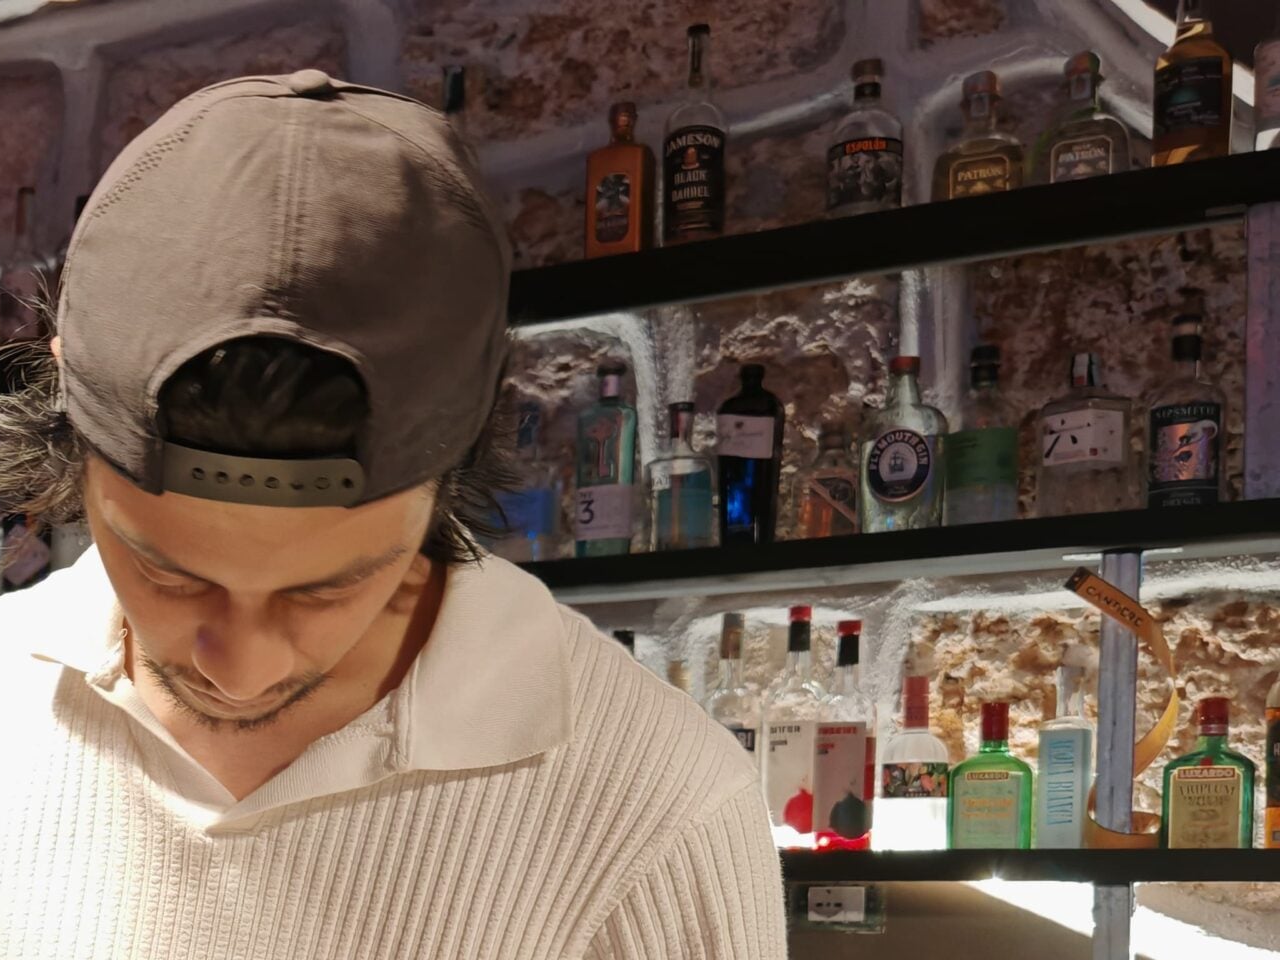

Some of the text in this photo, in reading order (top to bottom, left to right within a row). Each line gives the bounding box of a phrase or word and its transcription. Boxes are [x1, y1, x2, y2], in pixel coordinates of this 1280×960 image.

[666, 133, 721, 158] JAMESON
[673, 171, 708, 185] BLACK
[671, 186, 711, 202] BARREL
[869, 431, 919, 471] PLYMOUTH
[579, 499, 594, 525] 3
[1179, 769, 1234, 779] LUXARDO
